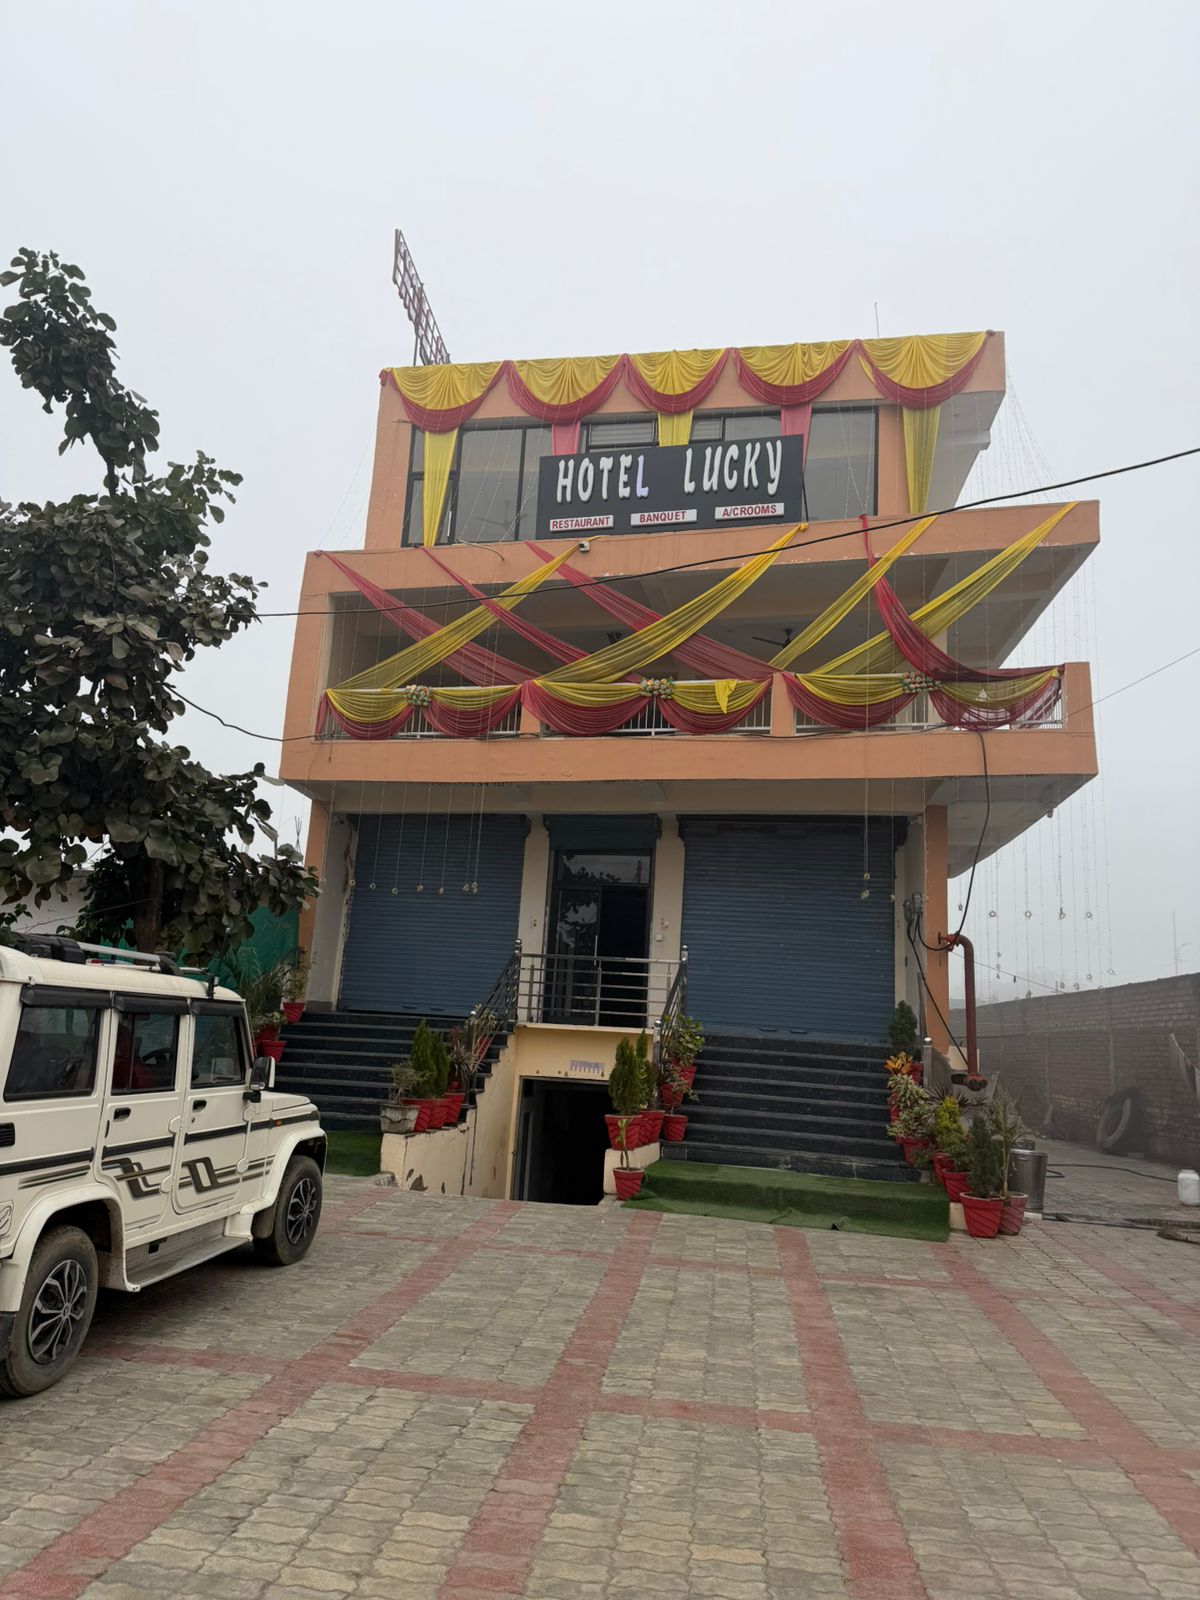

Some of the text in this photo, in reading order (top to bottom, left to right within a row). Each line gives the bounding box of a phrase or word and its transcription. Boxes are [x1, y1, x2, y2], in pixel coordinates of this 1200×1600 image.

[556, 440, 782, 503] HOTEL LUCKY
[552, 516, 610, 529] RESTAURANT
[639, 510, 687, 523] BANQUET
